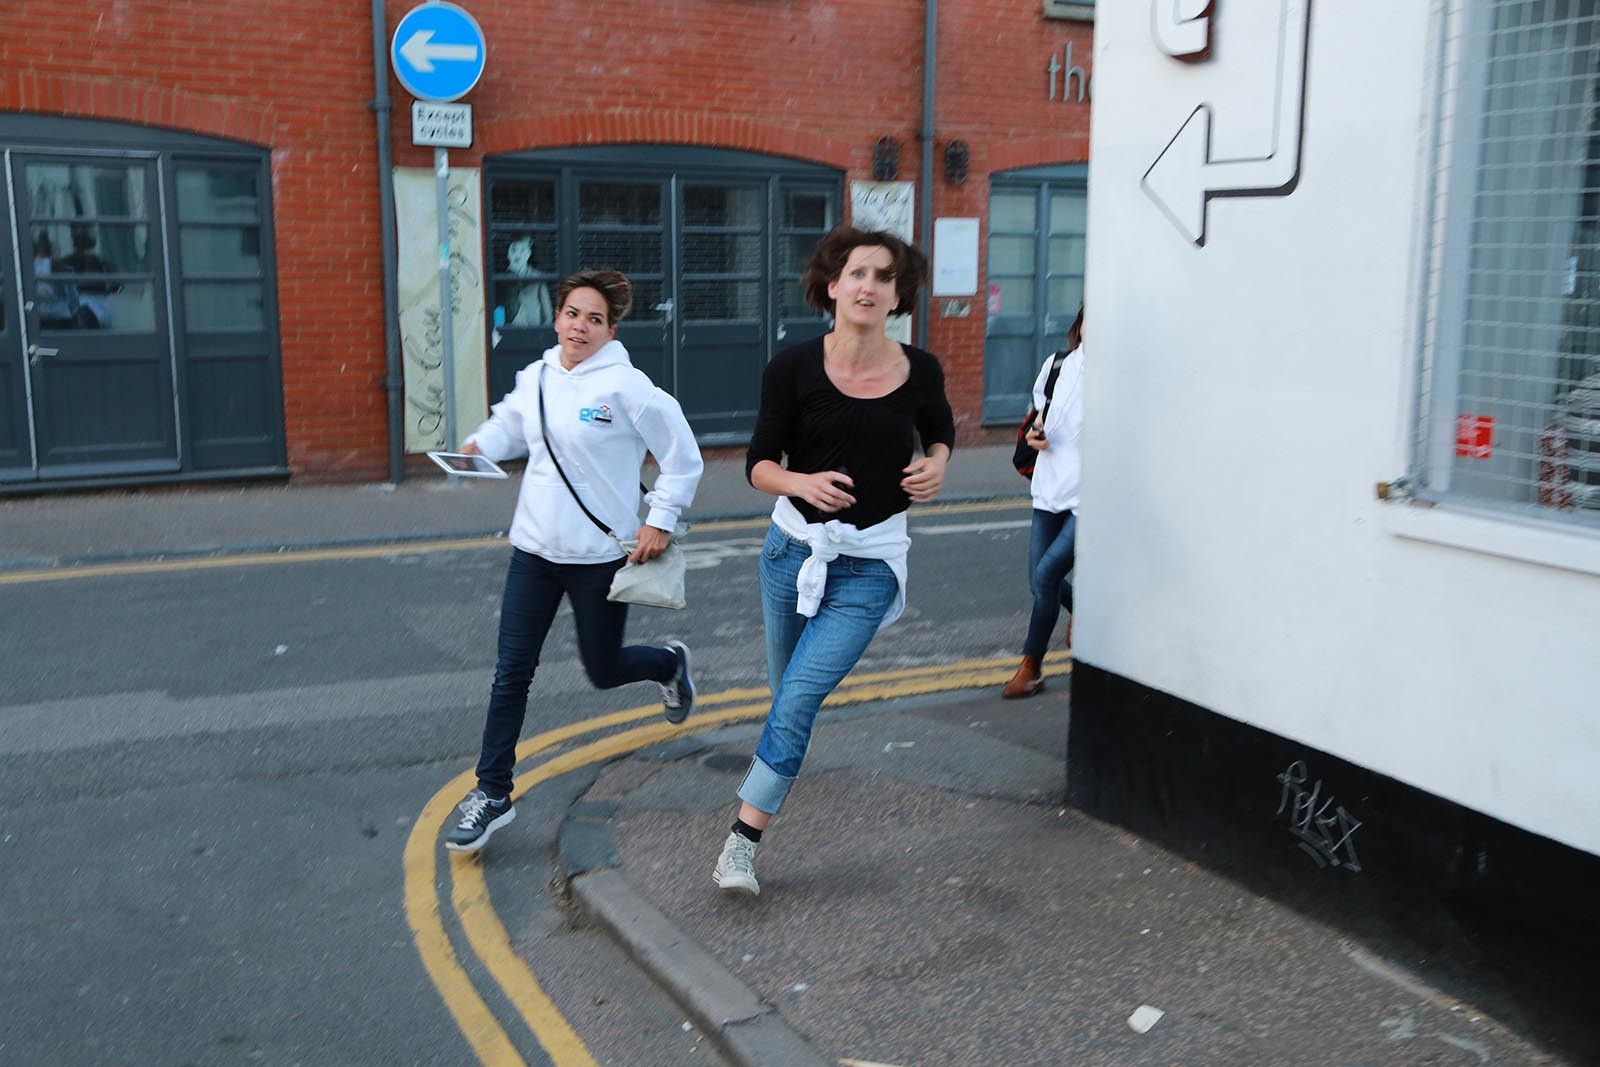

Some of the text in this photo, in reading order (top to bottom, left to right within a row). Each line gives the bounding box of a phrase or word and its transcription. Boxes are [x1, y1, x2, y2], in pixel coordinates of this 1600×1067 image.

[1048, 40, 1094, 102] th
[417, 108, 465, 123] Except
[419, 126, 465, 139] cycles
